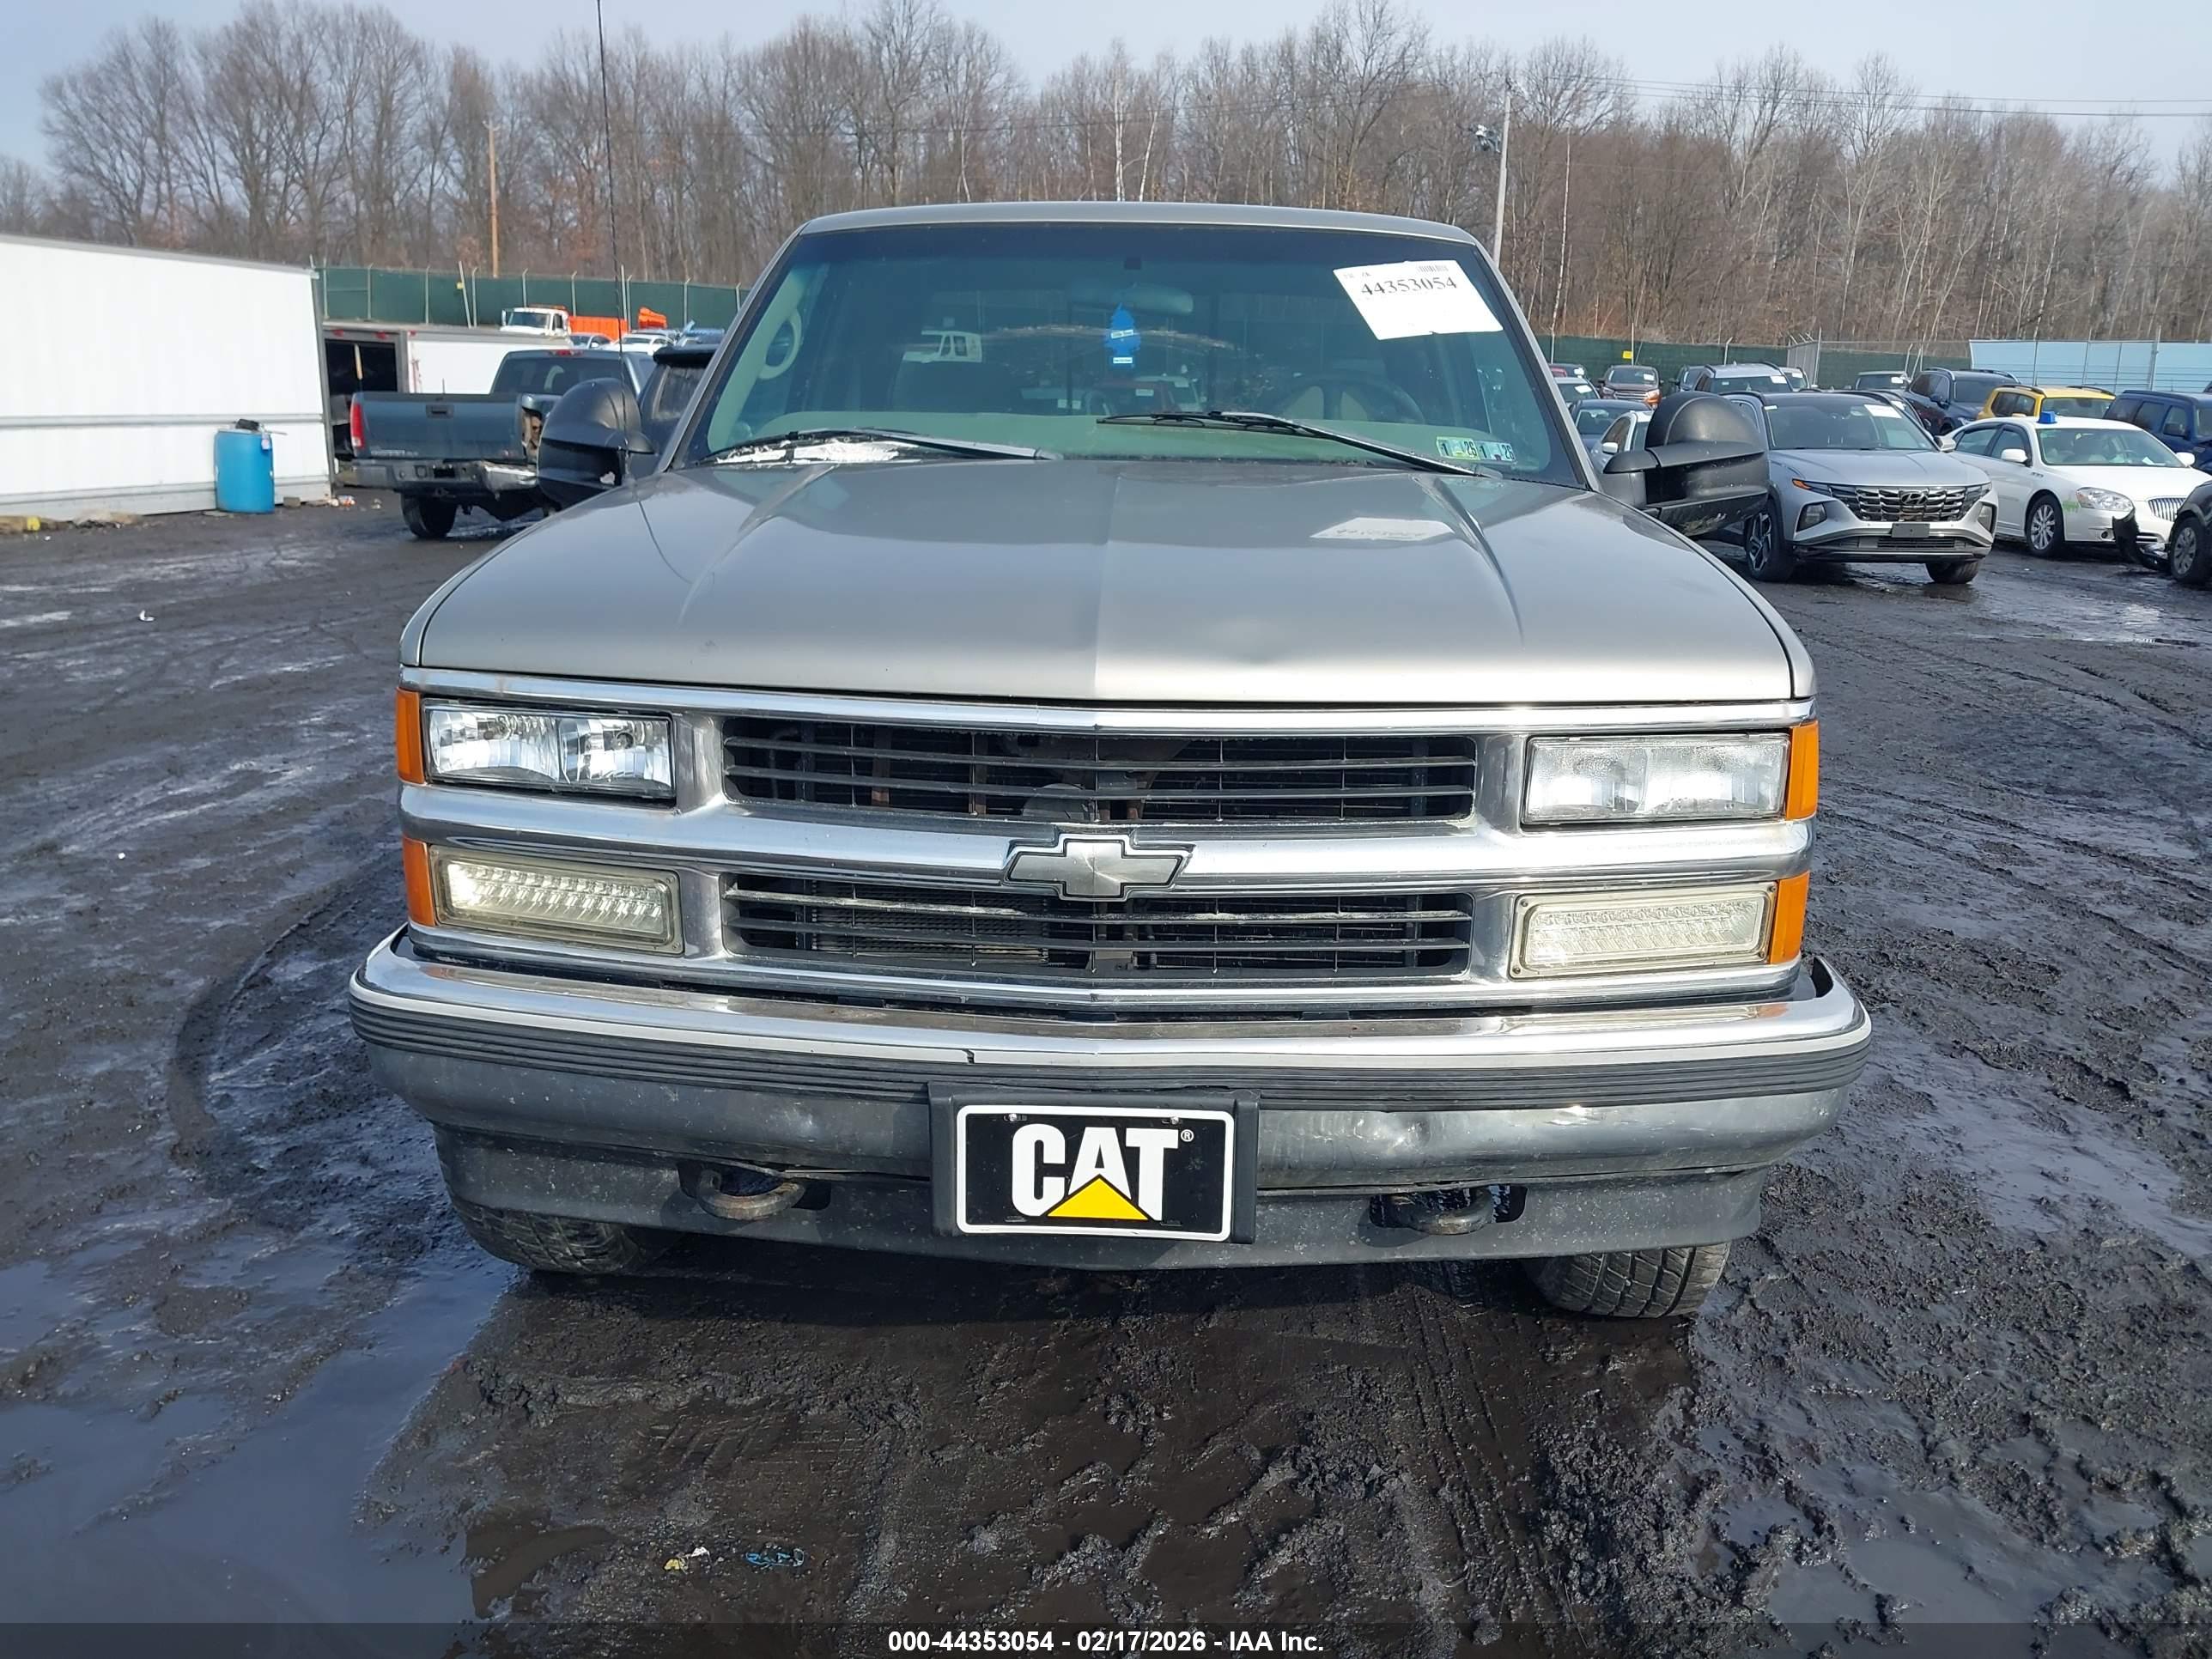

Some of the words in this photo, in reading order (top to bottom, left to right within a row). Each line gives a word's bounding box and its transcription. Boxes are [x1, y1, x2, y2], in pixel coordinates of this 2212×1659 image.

[1361, 276, 1457, 295] 44353054
[1464, 441, 1477, 457] 26
[1502, 444, 1515, 460] 26
